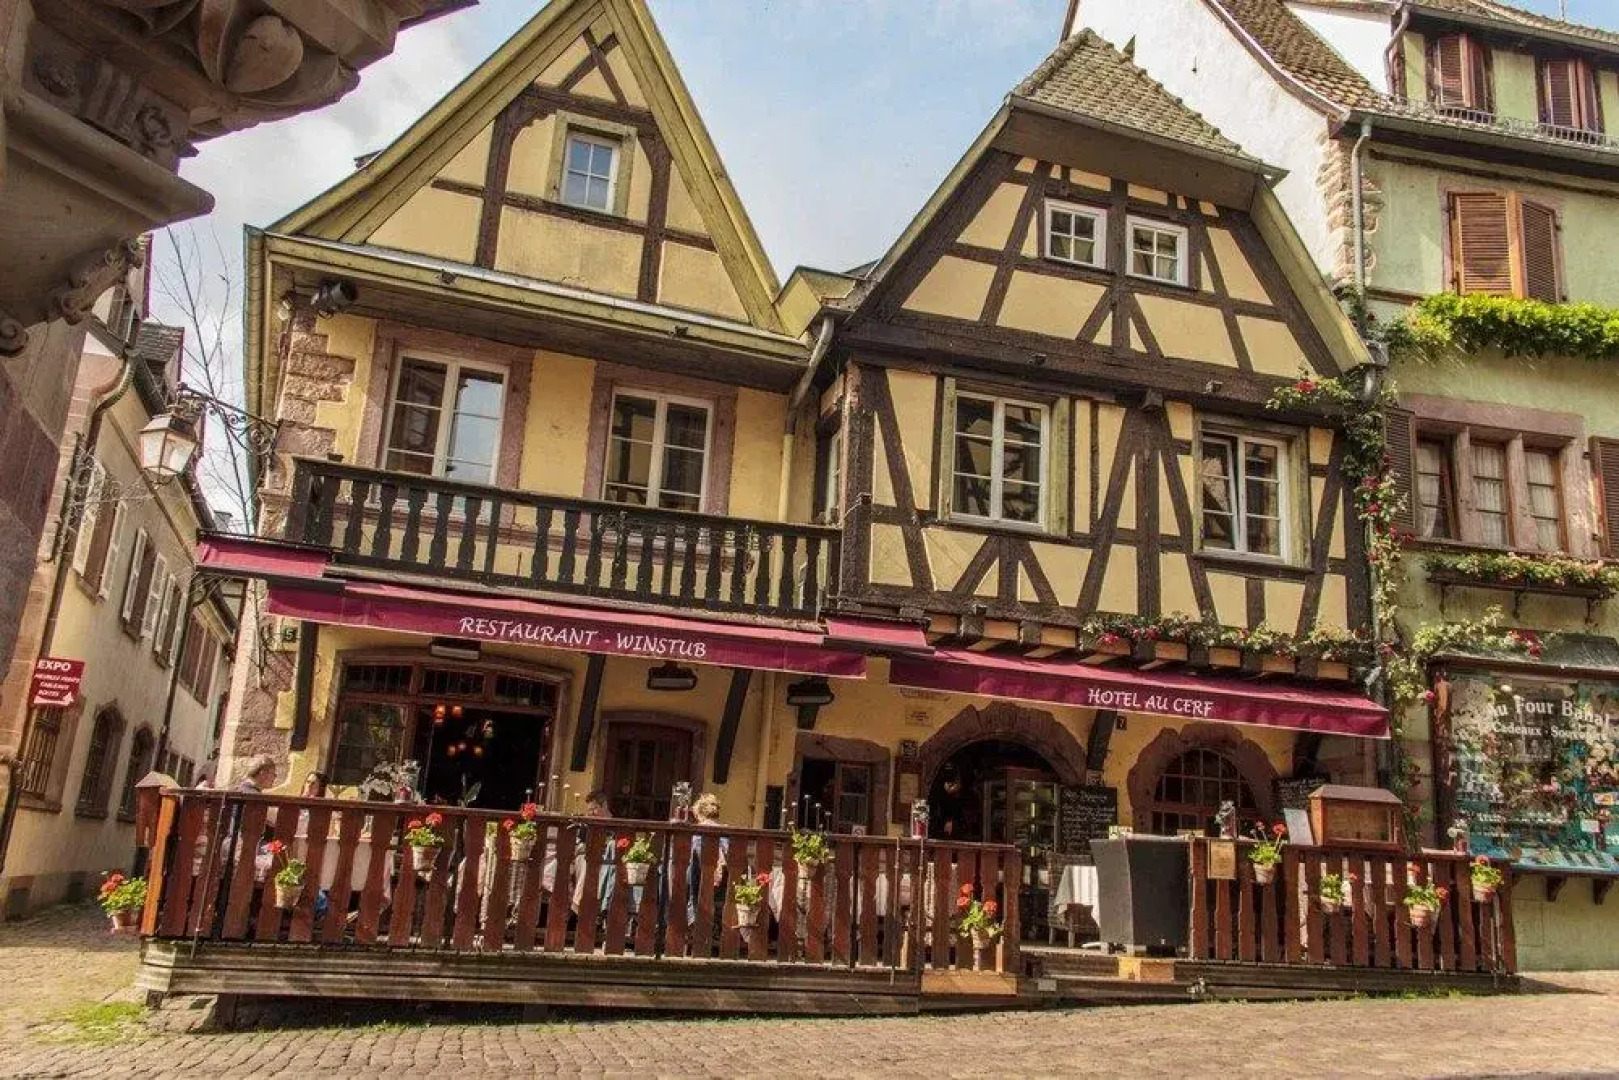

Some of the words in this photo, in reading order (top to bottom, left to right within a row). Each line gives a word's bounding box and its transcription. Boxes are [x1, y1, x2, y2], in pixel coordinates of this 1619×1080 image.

[459, 616, 597, 646] RESTAURANT
[616, 632, 707, 658] WINSTUB
[37, 659, 72, 672] EXPO
[1088, 688, 1141, 707] HOTEL
[1145, 695, 1168, 710] AU
[1173, 698, 1214, 717] CERF
[1487, 702, 1509, 717] Au
[1515, 697, 1555, 715] Four
[1561, 699, 1610, 727] Banal
